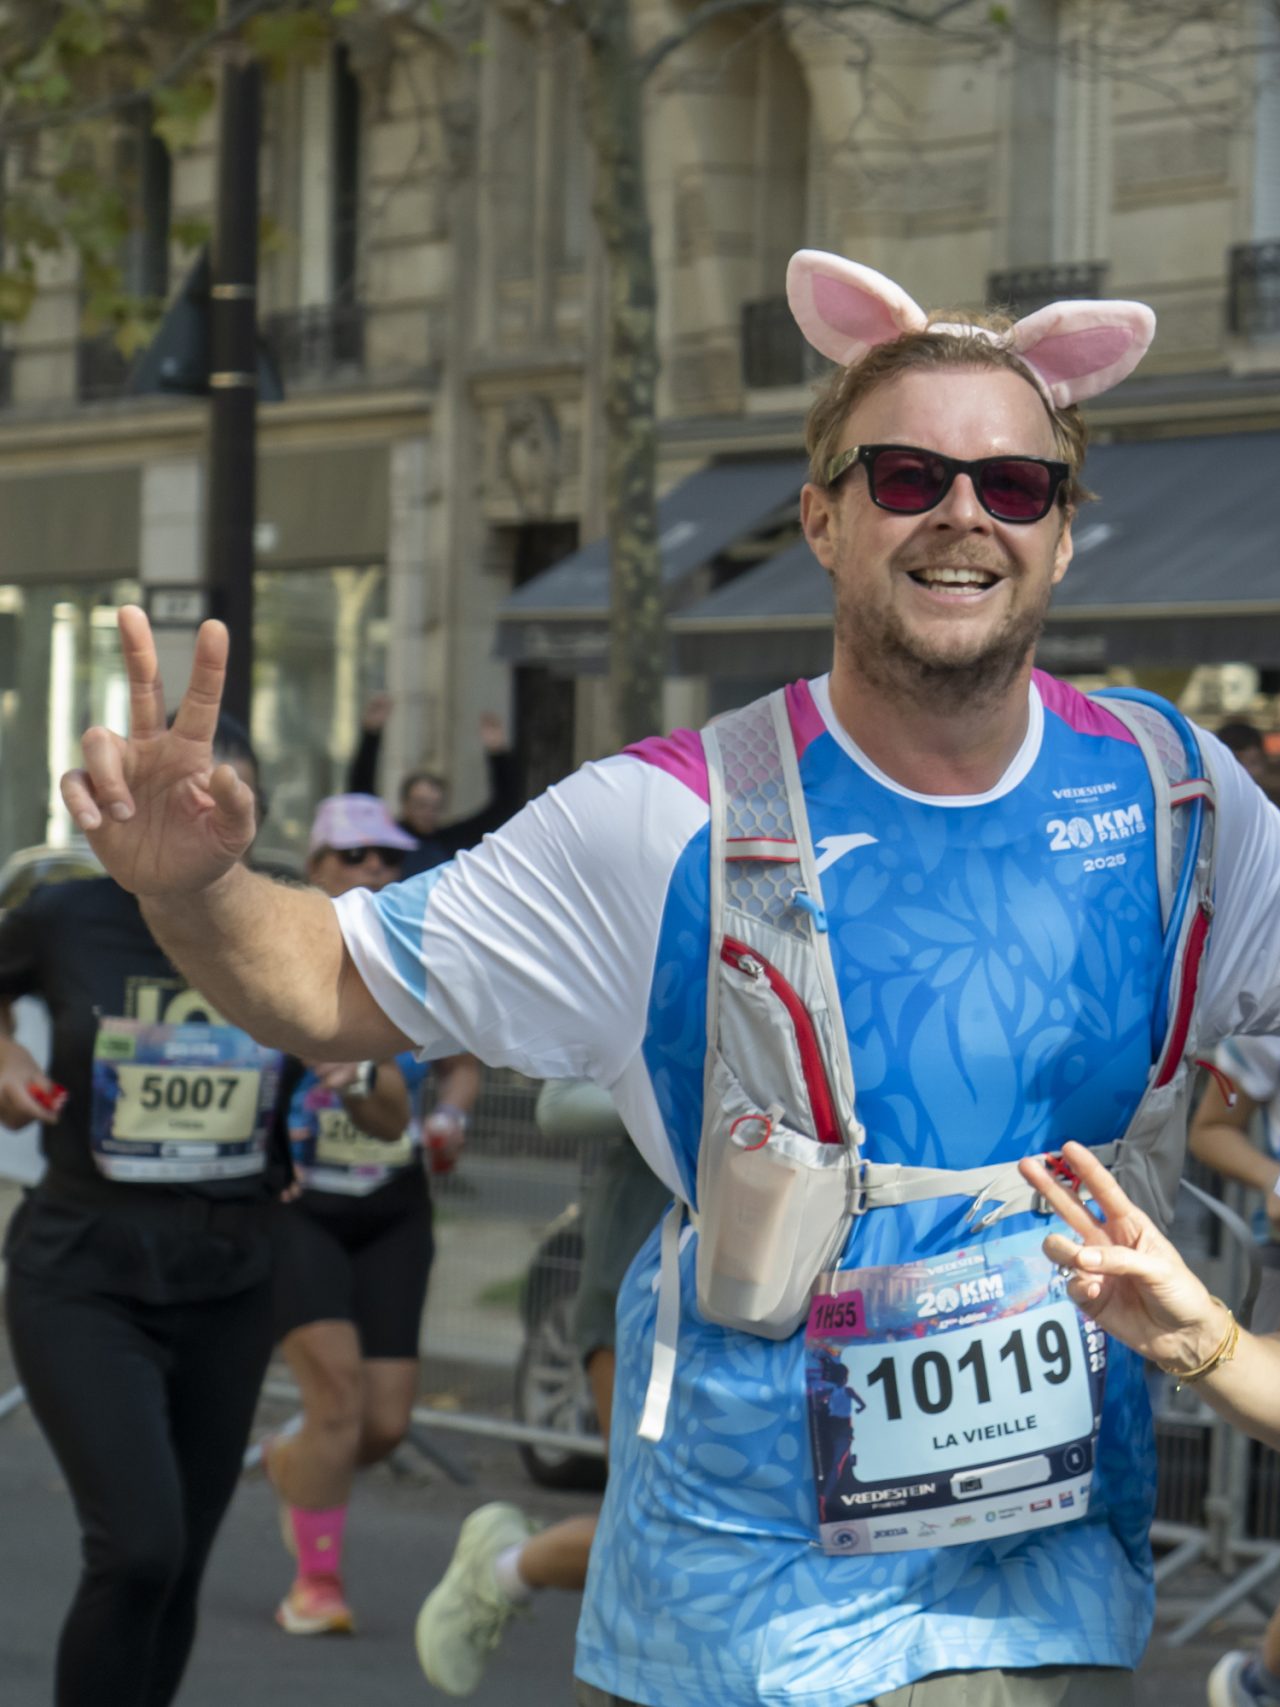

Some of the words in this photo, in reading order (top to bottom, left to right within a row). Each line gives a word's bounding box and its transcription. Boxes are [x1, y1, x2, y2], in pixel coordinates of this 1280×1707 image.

[1046, 817, 1094, 851] 20
[1093, 803, 1144, 833] KM
[1099, 821, 1146, 843] PARIS
[1083, 853, 1127, 872] 2025
[141, 1074, 239, 1110] 5007
[916, 1287, 960, 1317] 20
[960, 1273, 1002, 1295] KM
[815, 1301, 857, 1328] 1H55
[866, 1319, 1072, 1422] 10119
[932, 1434, 959, 1450] LA
[962, 1414, 1038, 1444] VIEILLE
[840, 1482, 936, 1506] VREDESTEIN
